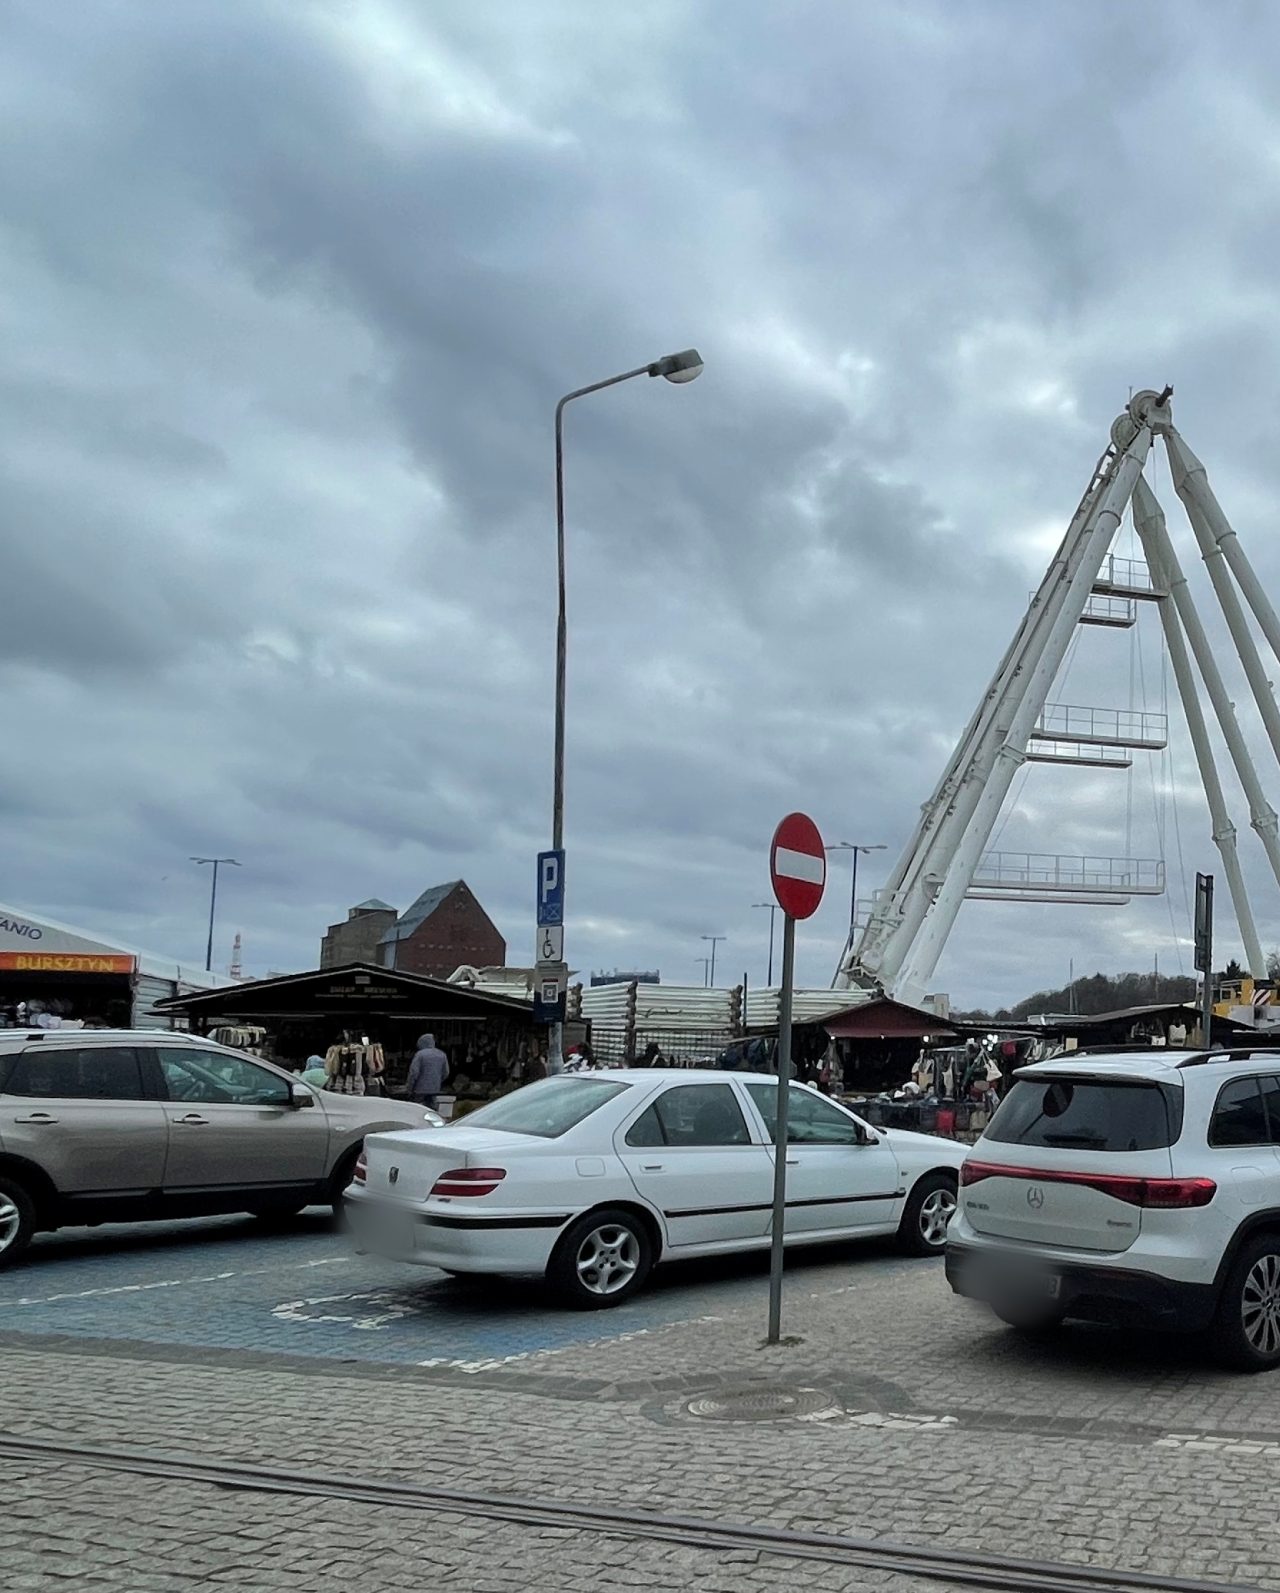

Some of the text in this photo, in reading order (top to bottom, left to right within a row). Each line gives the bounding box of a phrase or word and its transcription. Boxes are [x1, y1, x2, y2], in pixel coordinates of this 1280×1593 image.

[542, 858, 558, 902] P
[0, 917, 42, 940] ANIO
[16, 955, 114, 971] BURSZTYN
